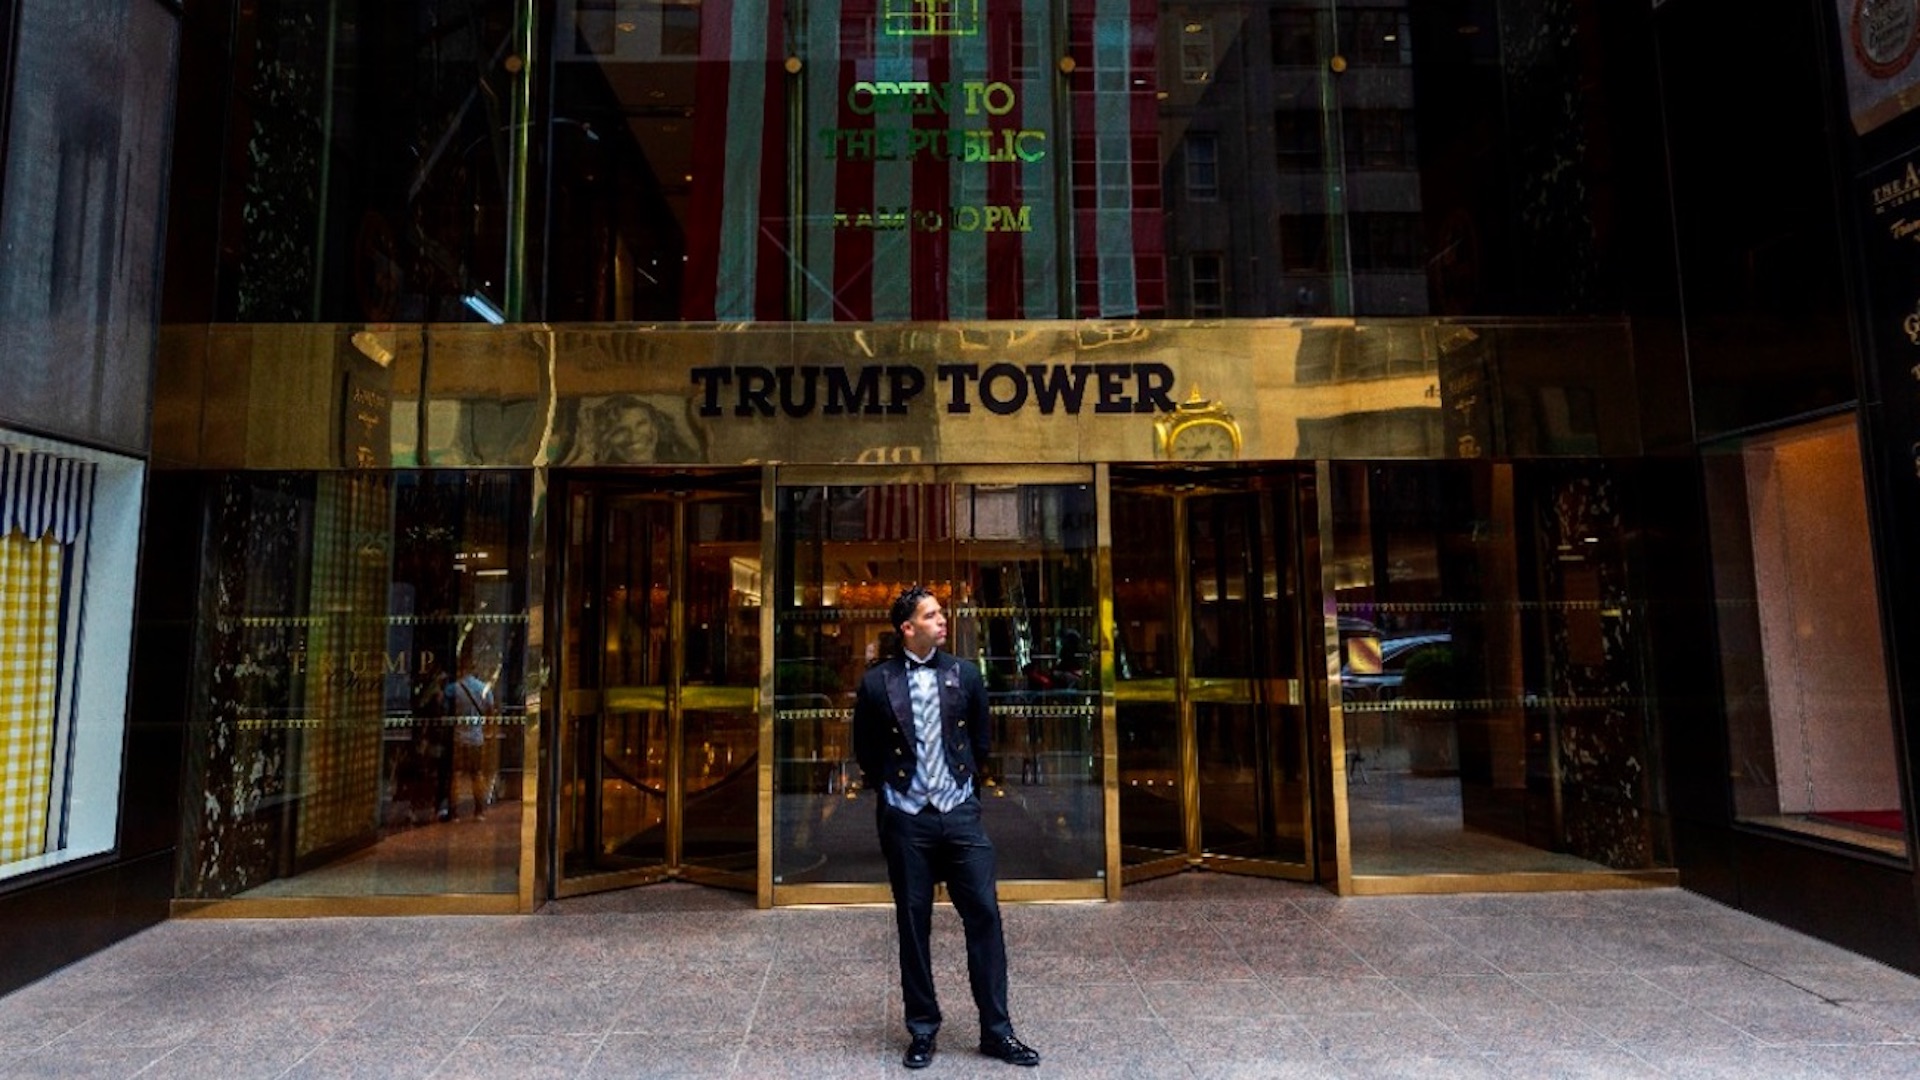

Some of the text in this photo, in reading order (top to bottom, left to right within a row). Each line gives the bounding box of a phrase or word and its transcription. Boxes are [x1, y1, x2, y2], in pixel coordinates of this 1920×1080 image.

[846, 81, 1016, 117] OPEN TO
[819, 127, 1047, 162] THE PUBLIC
[1870, 178, 1901, 204] THE
[691, 361, 1177, 418] TRUMP TOWER
[287, 649, 437, 675] TRUMP
